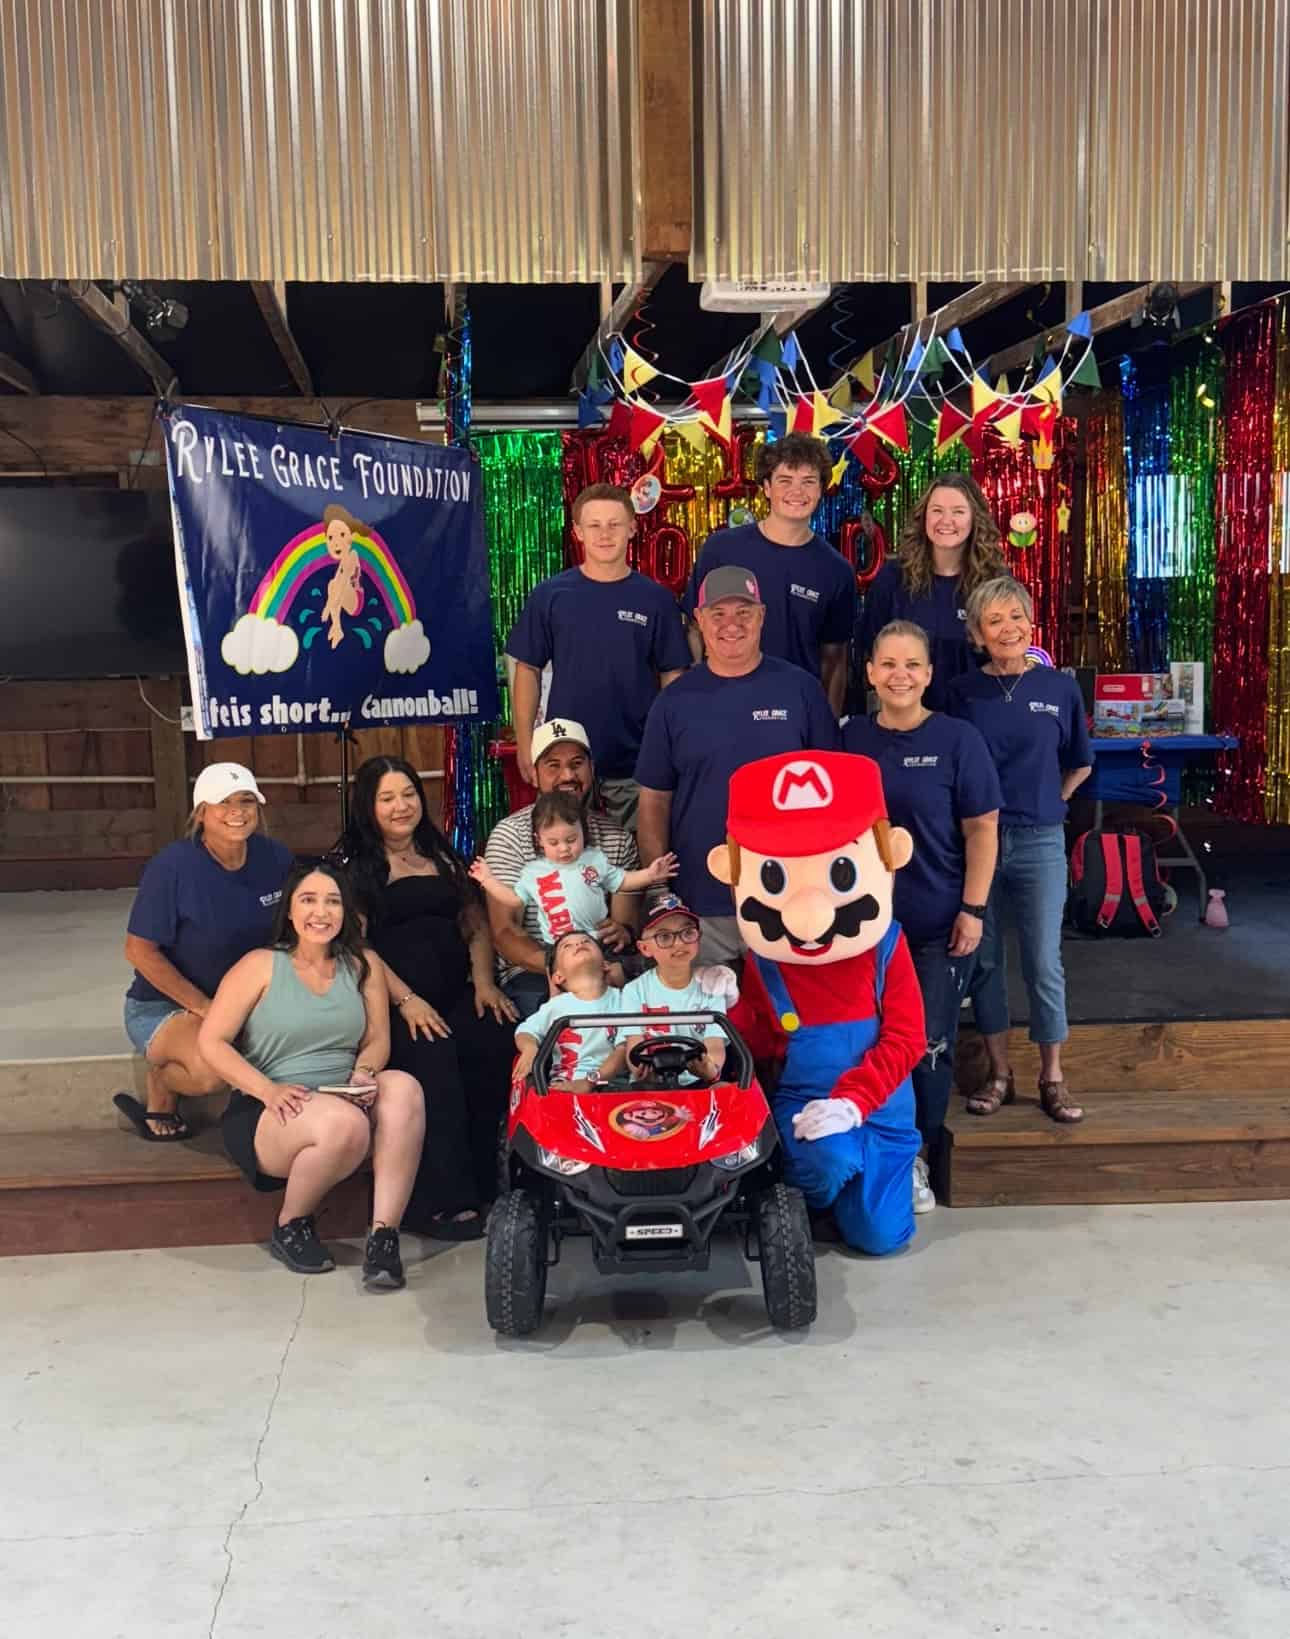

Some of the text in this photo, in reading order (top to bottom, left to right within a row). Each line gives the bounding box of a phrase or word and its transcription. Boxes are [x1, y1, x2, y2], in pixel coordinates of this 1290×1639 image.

[171, 420, 471, 504] RYLEE GRACE FOUNDATION
[361, 689, 479, 720] Cannonball!
[551, 721, 568, 738] LA
[778, 766, 828, 805] M
